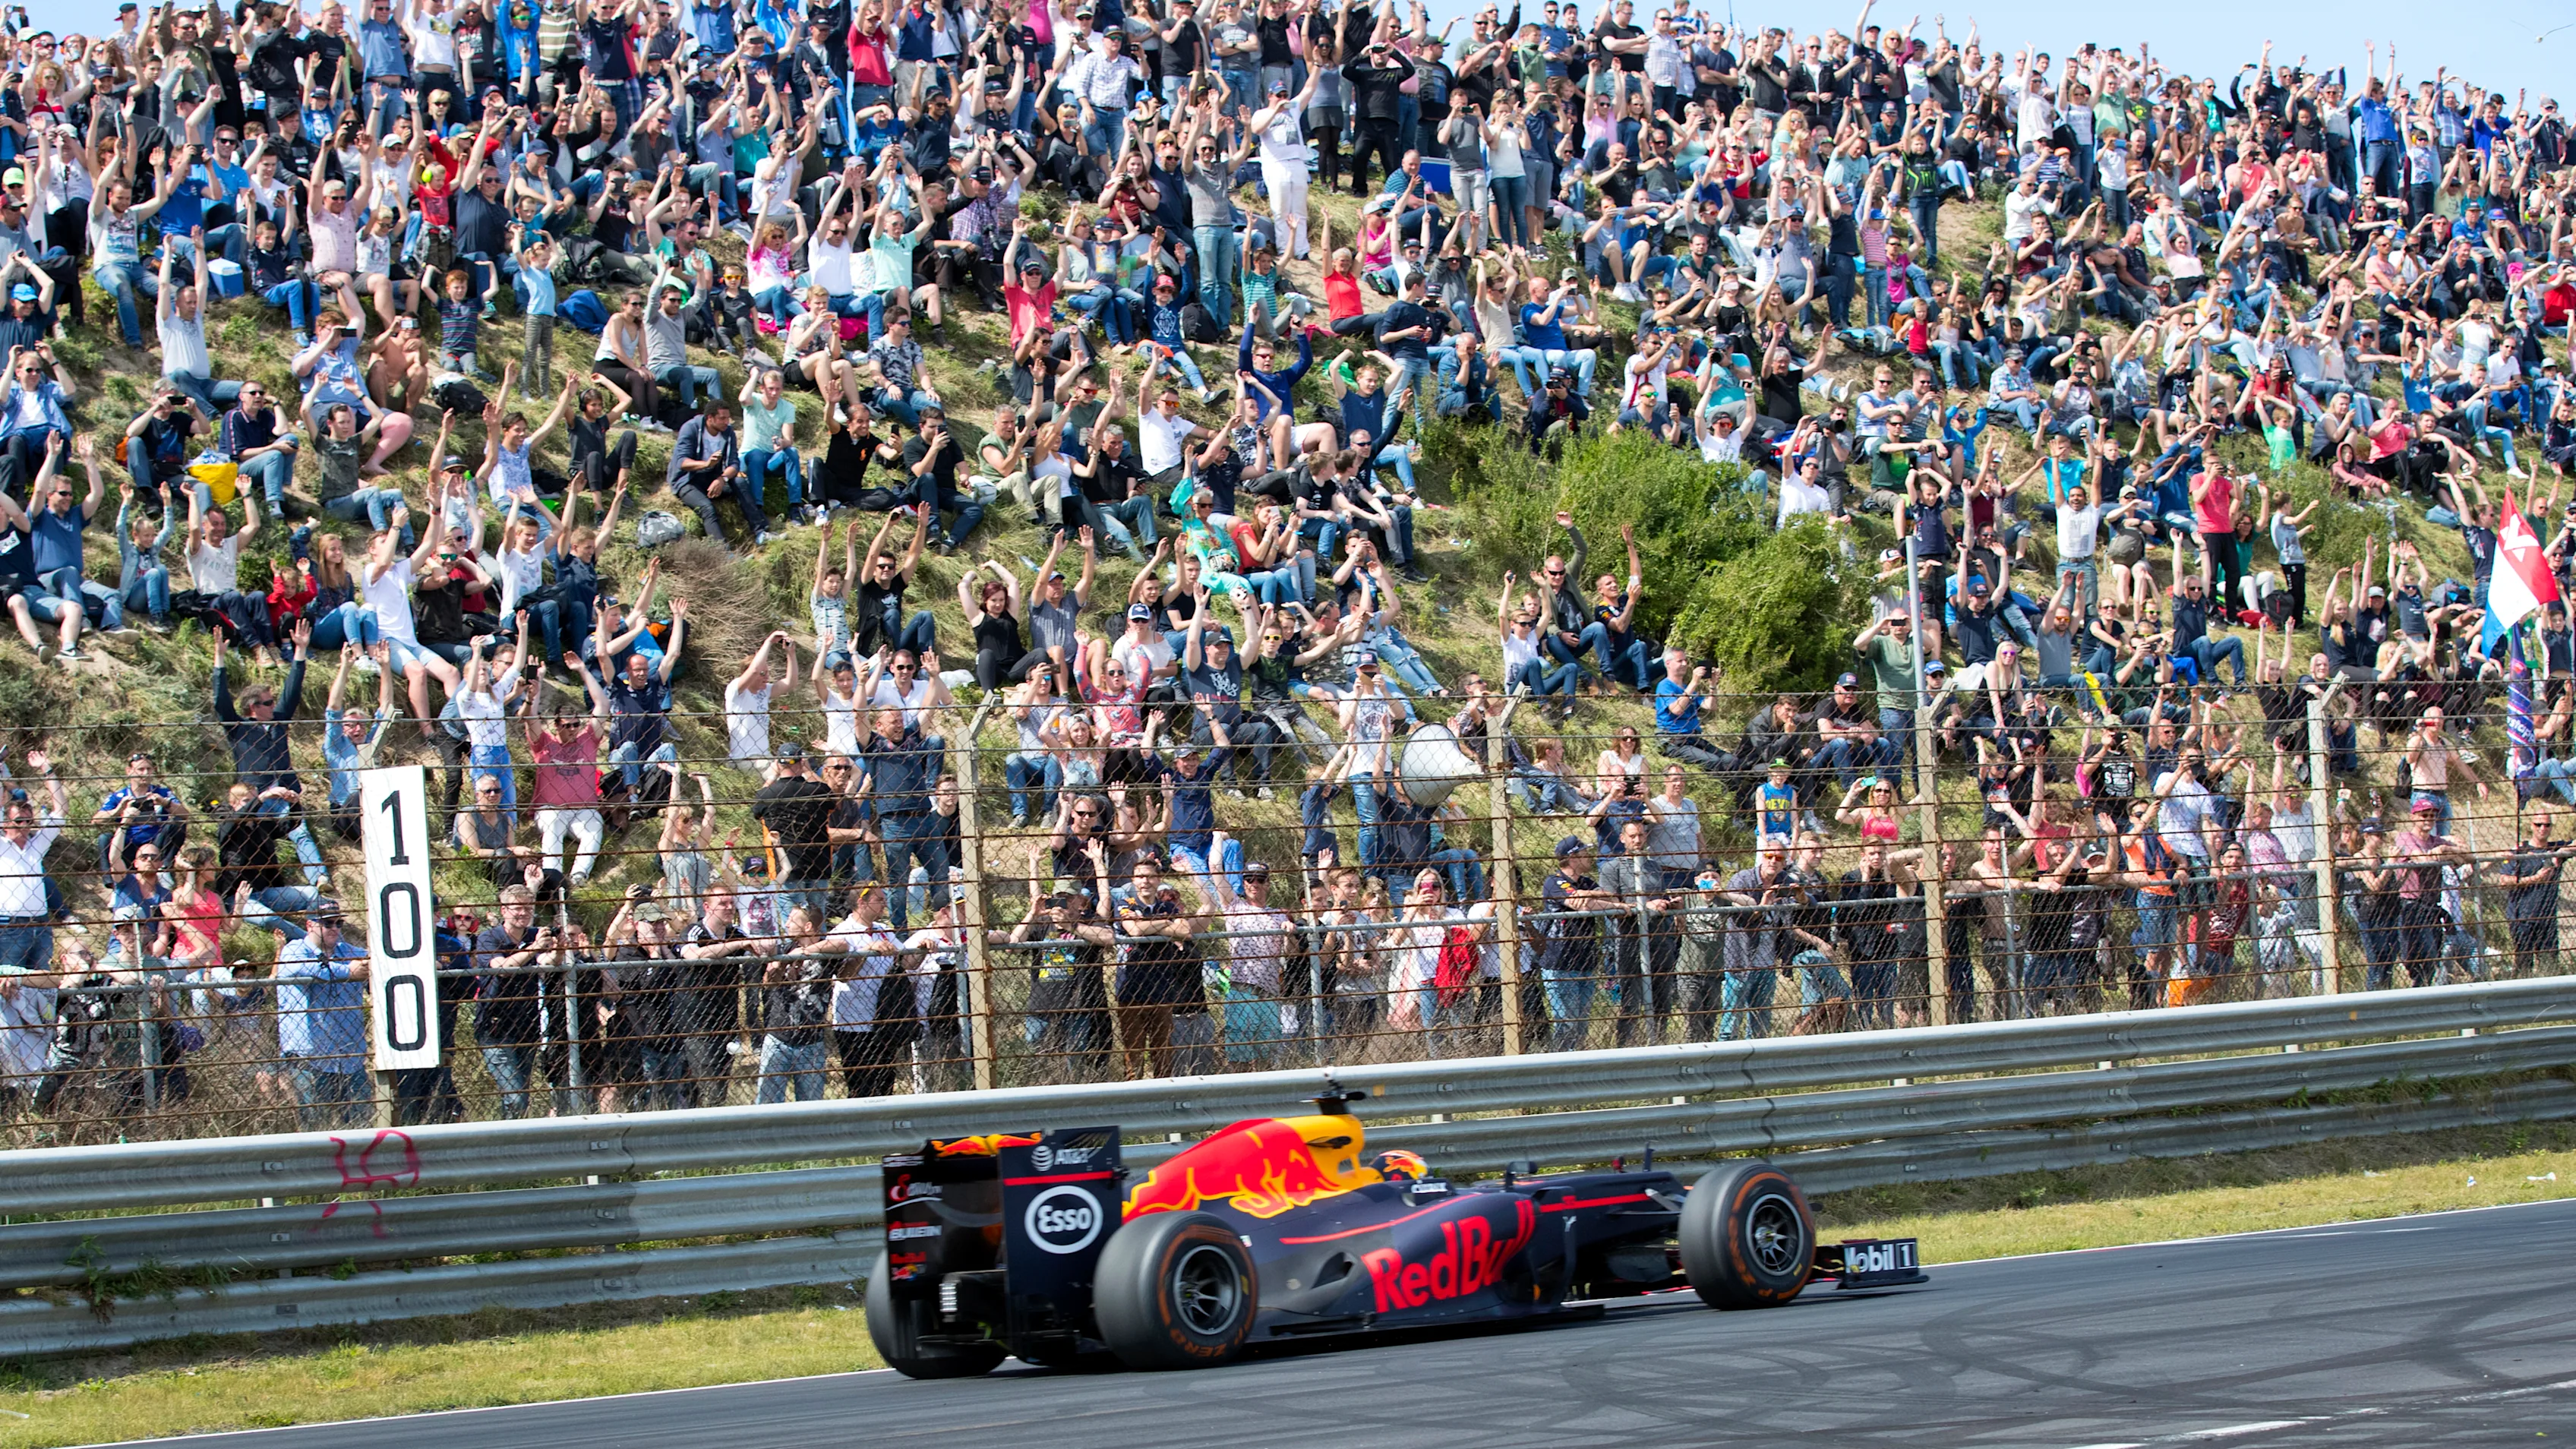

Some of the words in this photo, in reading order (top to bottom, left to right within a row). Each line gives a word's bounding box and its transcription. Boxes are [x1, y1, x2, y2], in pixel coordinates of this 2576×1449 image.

[380, 790, 426, 1052] 100
[1037, 1204, 1092, 1233] Esso
[1844, 1243, 1896, 1274] Mobil
